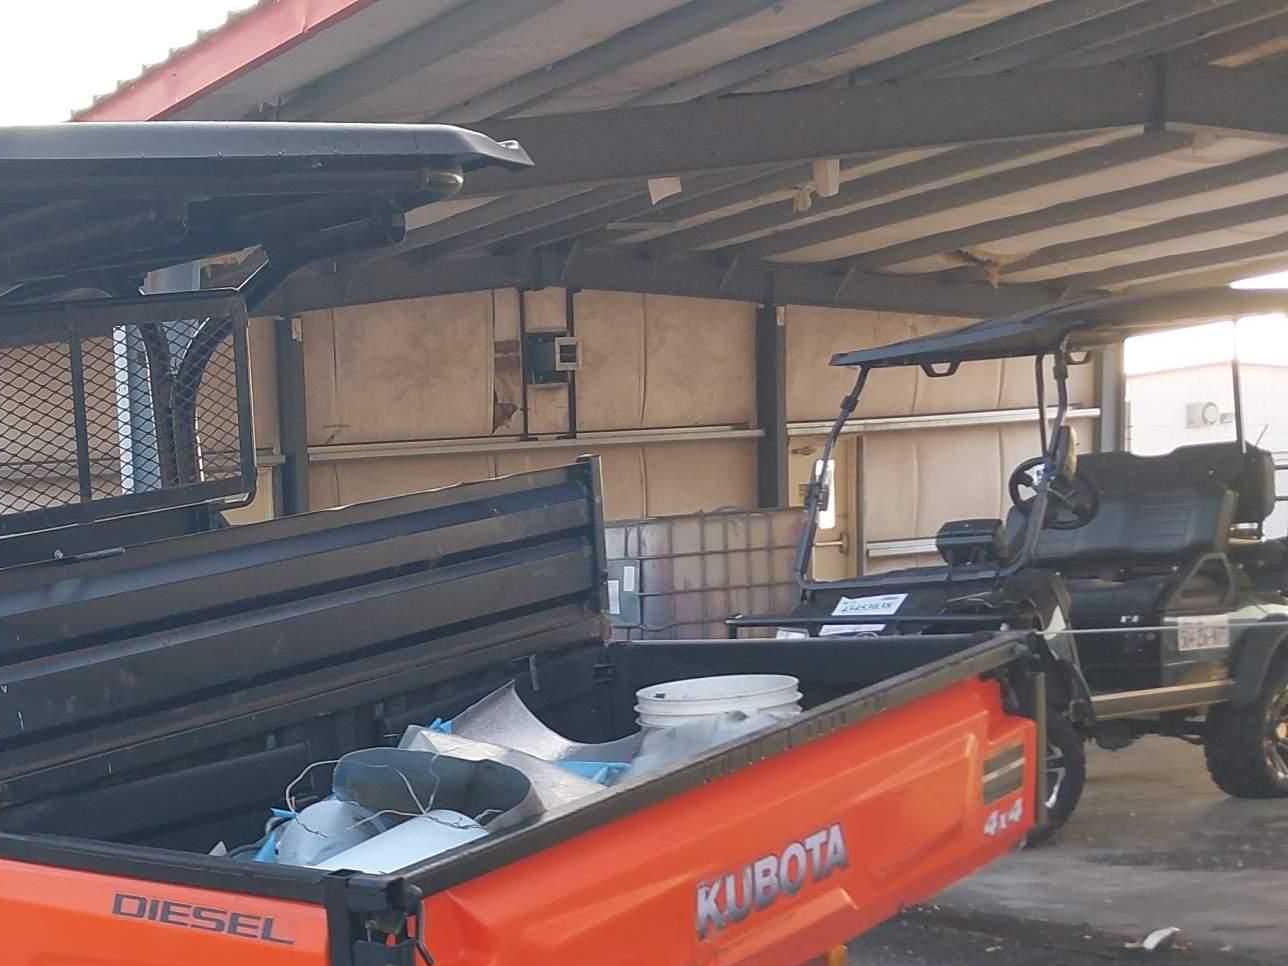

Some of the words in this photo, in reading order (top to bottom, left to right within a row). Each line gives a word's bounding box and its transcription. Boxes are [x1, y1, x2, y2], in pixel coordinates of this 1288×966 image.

[983, 797, 1025, 837] 4x4
[695, 822, 850, 942] KUBOTA
[112, 893, 295, 945] DIESEL
